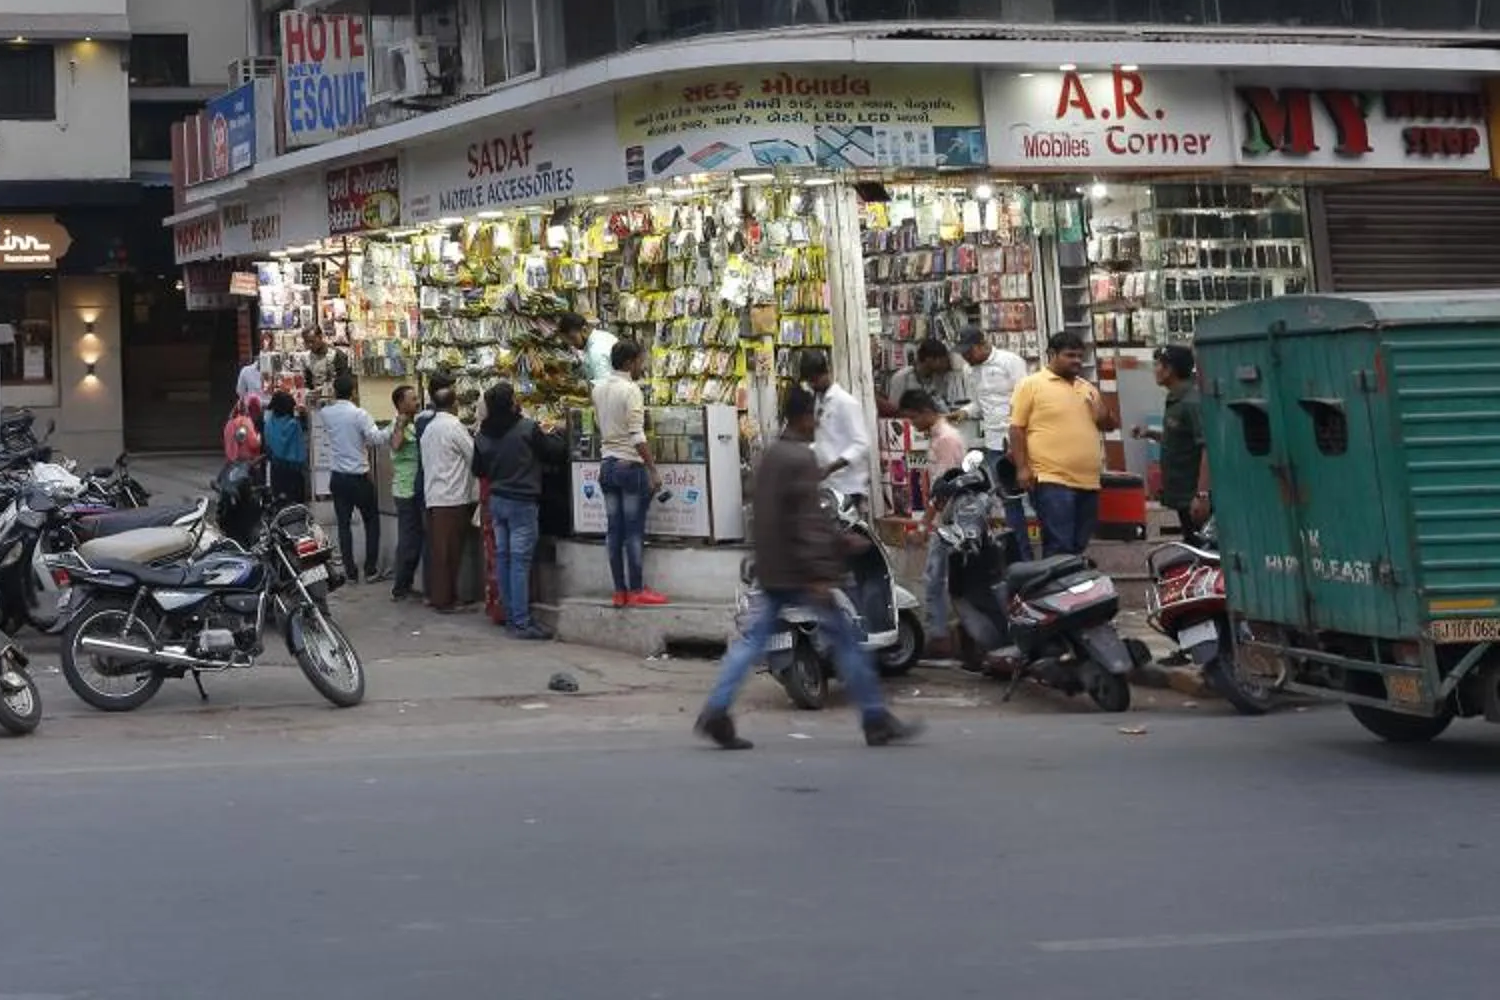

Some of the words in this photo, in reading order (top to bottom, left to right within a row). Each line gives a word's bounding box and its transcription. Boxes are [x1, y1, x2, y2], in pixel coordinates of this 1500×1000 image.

[1055, 64, 1166, 121] A.R.
[1022, 131, 1091, 159] Mobiles
[1105, 125, 1212, 155] Corner
[1237, 86, 1380, 155] MY
[466, 128, 535, 180] SADAF
[438, 183, 485, 213] MOBILE
[487, 166, 576, 203] ACCESSORIES
